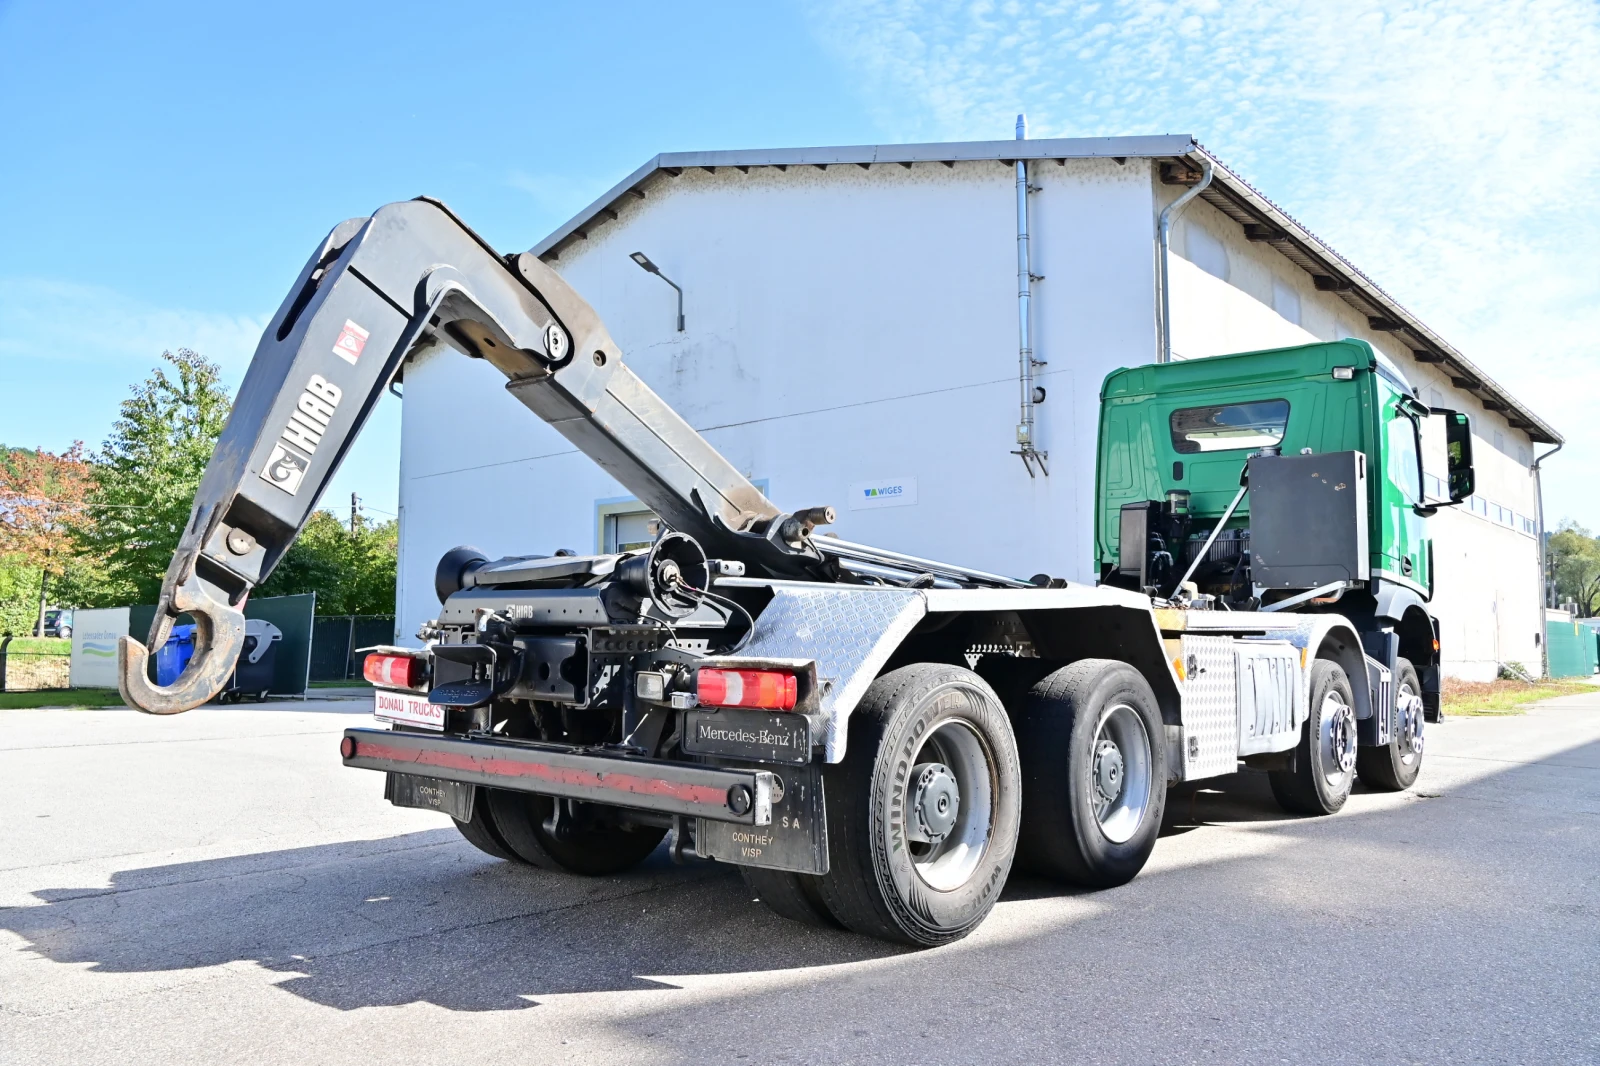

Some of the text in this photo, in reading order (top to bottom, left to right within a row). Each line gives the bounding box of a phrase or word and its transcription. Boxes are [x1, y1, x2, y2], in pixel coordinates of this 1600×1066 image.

[281, 374, 342, 456] HIAB
[878, 486, 903, 495] WIGES
[515, 604, 534, 619] HIAB
[378, 696, 442, 718] DONAU TRUCKS
[699, 725, 789, 746] Mercedes-Benz
[890, 692, 962, 853] WINDPOWER
[419, 785, 447, 798] CONTHEY
[427, 797, 442, 806] VISP
[732, 831, 774, 846] CONTHEY
[741, 847, 762, 858] VISP
